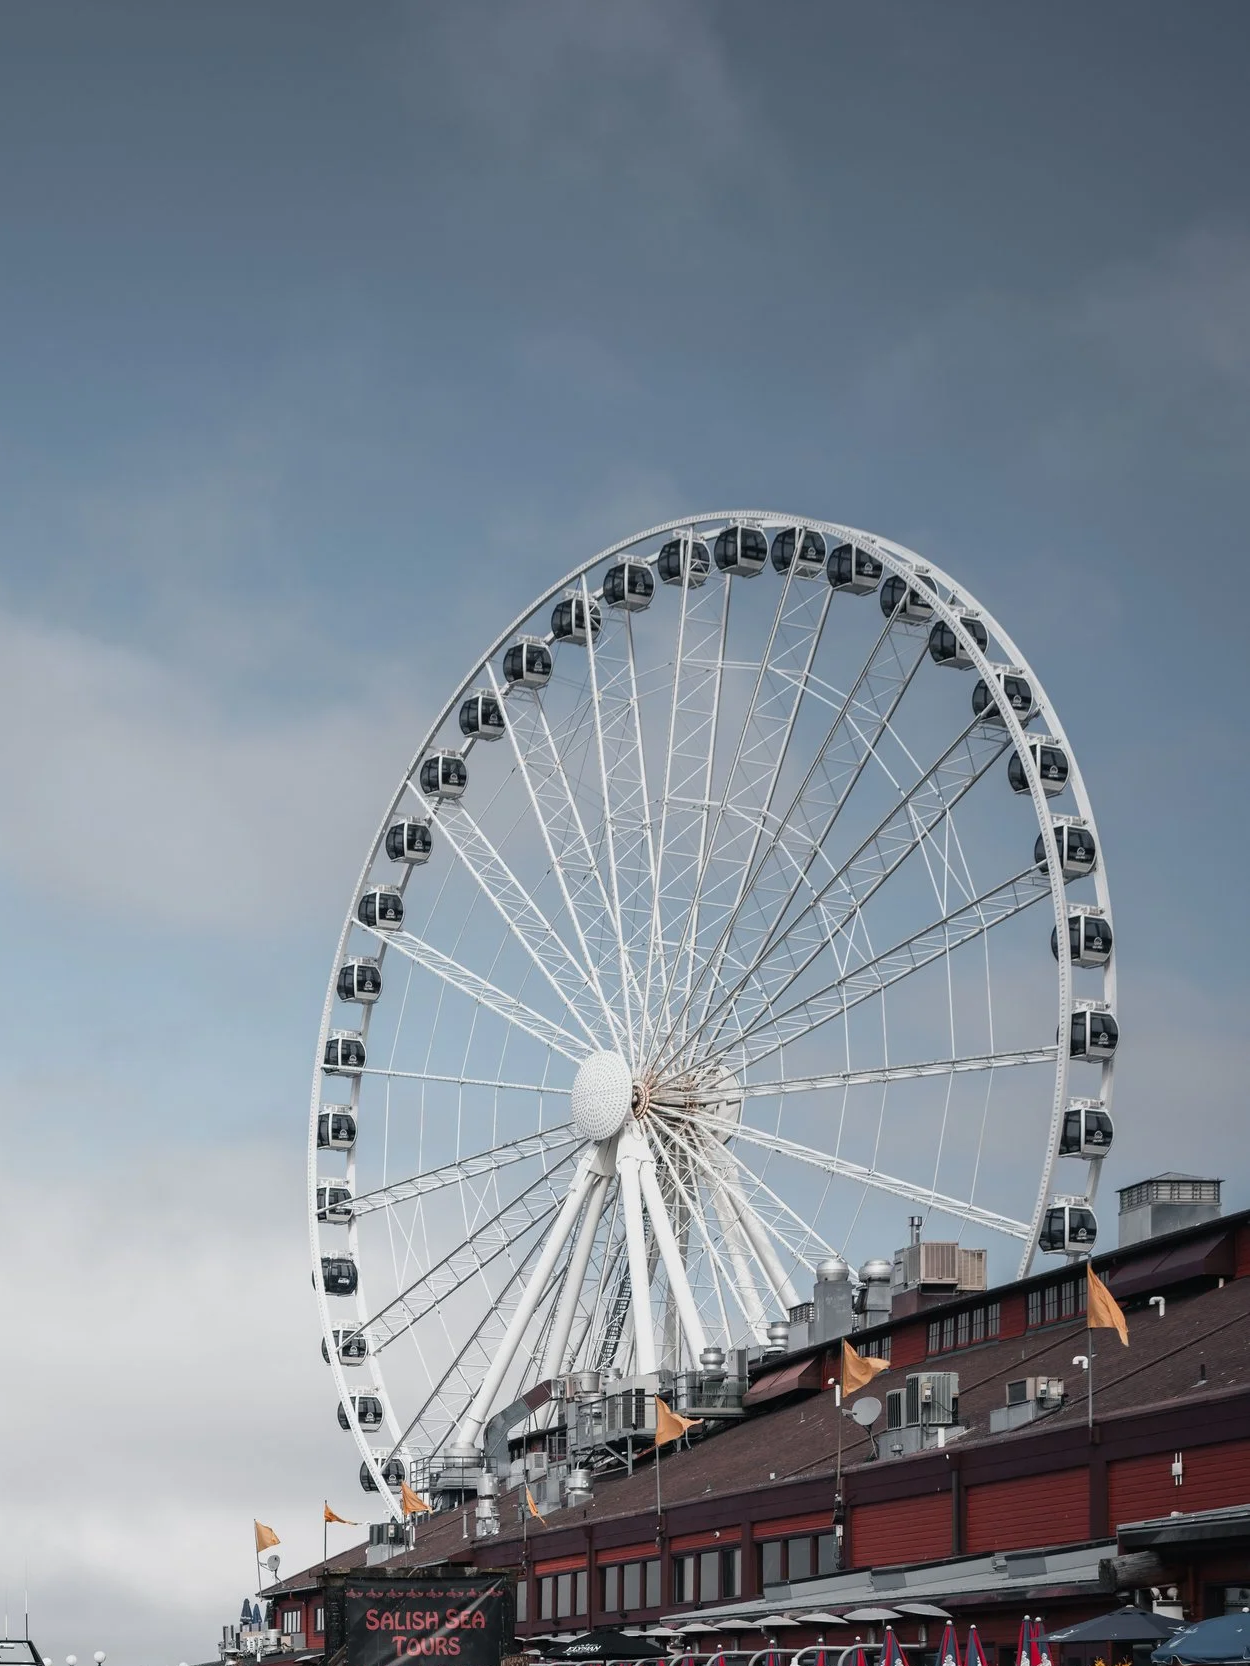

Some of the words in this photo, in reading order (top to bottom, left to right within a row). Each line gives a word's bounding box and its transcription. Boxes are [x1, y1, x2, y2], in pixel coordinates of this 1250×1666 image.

[365, 1608, 439, 1630] SALISH
[445, 1608, 486, 1629] SEA
[392, 1635, 461, 1657] TOURS
